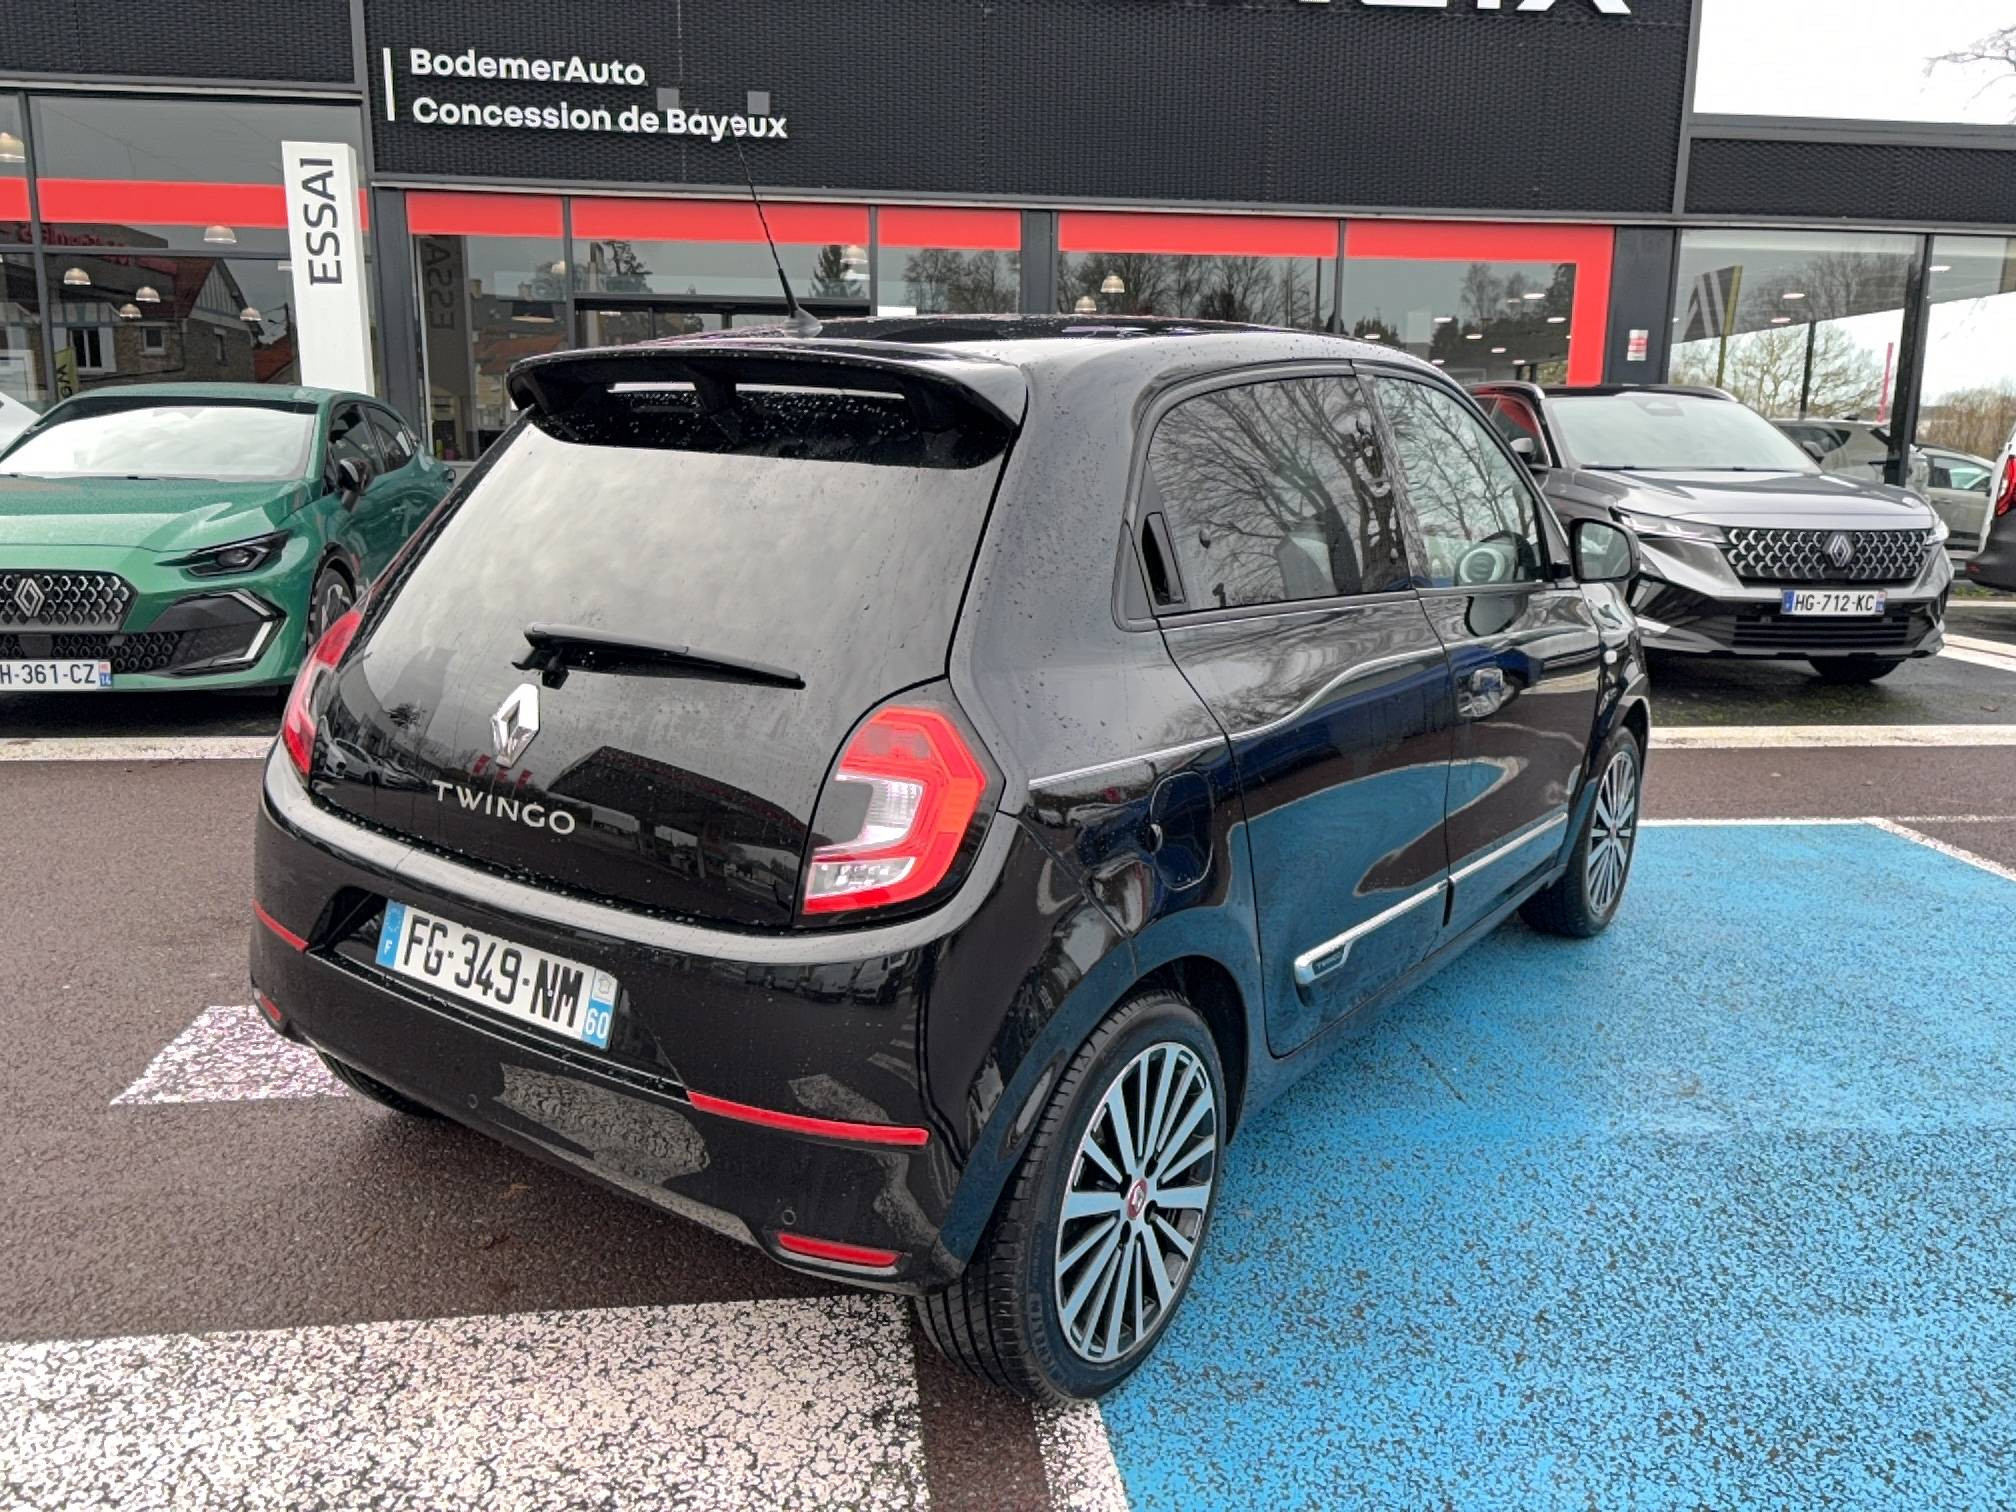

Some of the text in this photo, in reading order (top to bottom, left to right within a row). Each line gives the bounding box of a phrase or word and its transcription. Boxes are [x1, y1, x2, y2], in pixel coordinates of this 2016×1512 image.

[410, 47, 647, 85] BodemerAuto
[412, 96, 788, 143] Concession de Bayeux
[299, 157, 343, 286] ESSAI
[1794, 593, 1875, 612] HG-712-KC
[432, 779, 576, 836] TWINGO
[403, 914, 584, 1029] FG-349-NM
[585, 1008, 610, 1040] 60
